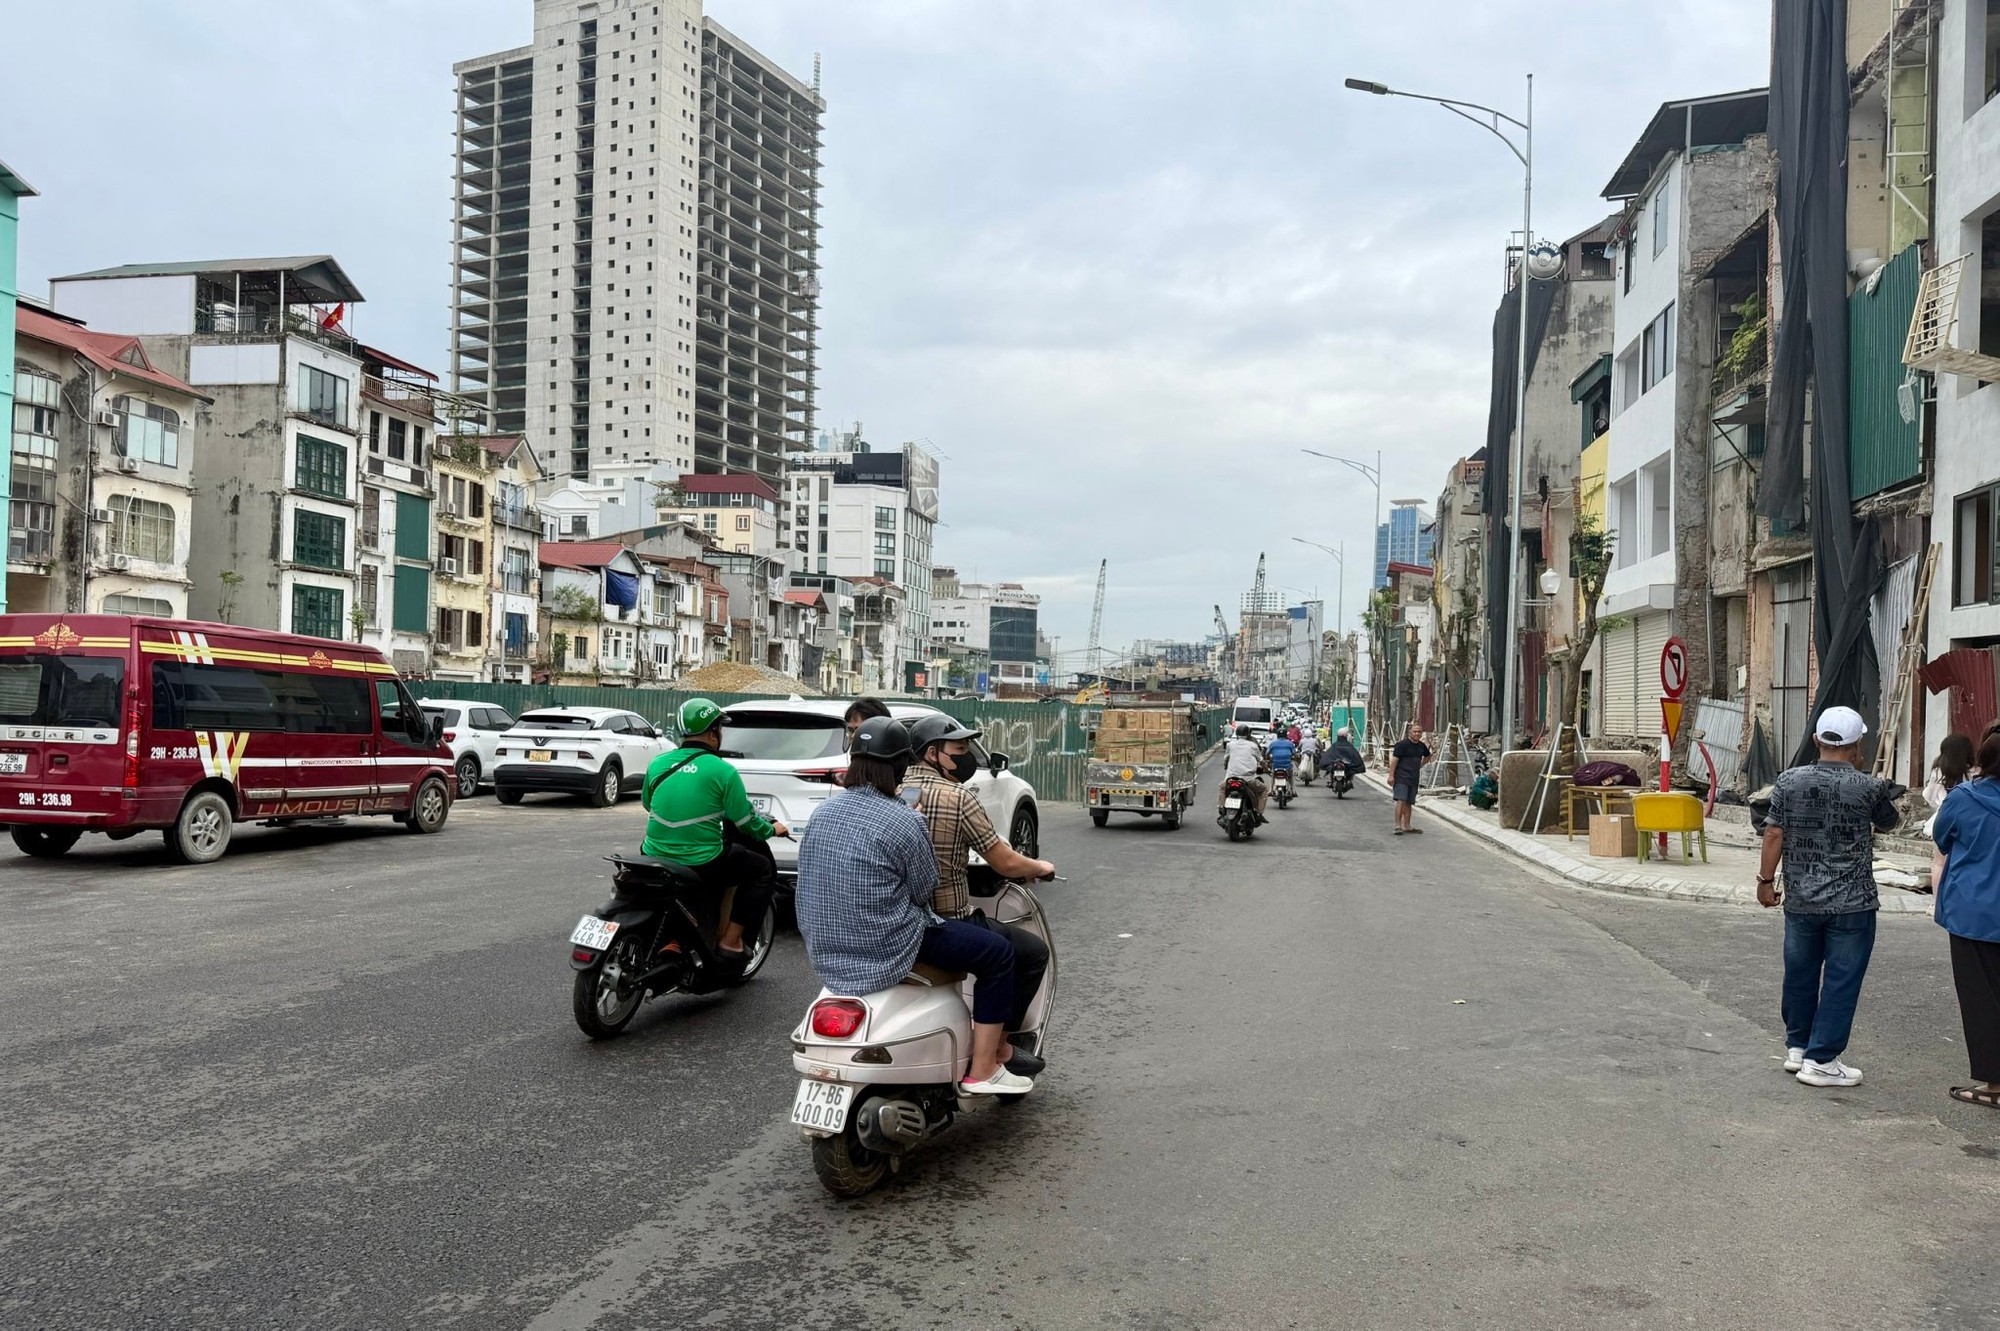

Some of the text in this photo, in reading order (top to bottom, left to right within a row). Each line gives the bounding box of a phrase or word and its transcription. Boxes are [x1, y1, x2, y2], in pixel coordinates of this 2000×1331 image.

[699, 705, 718, 719] Grab
[5, 754, 19, 763] 29H
[151, 747, 166, 759] 29H
[173, 747, 198, 759] 236.98
[19, 792, 36, 805] 29H
[43, 793, 72, 806] 236.98
[257, 797, 393, 815] LIMOUSINE
[582, 919, 613, 935] 29-A
[573, 930, 609, 948] 448.18
[806, 1082, 844, 1105] 17-B6
[794, 1102, 844, 1129] 400.09
